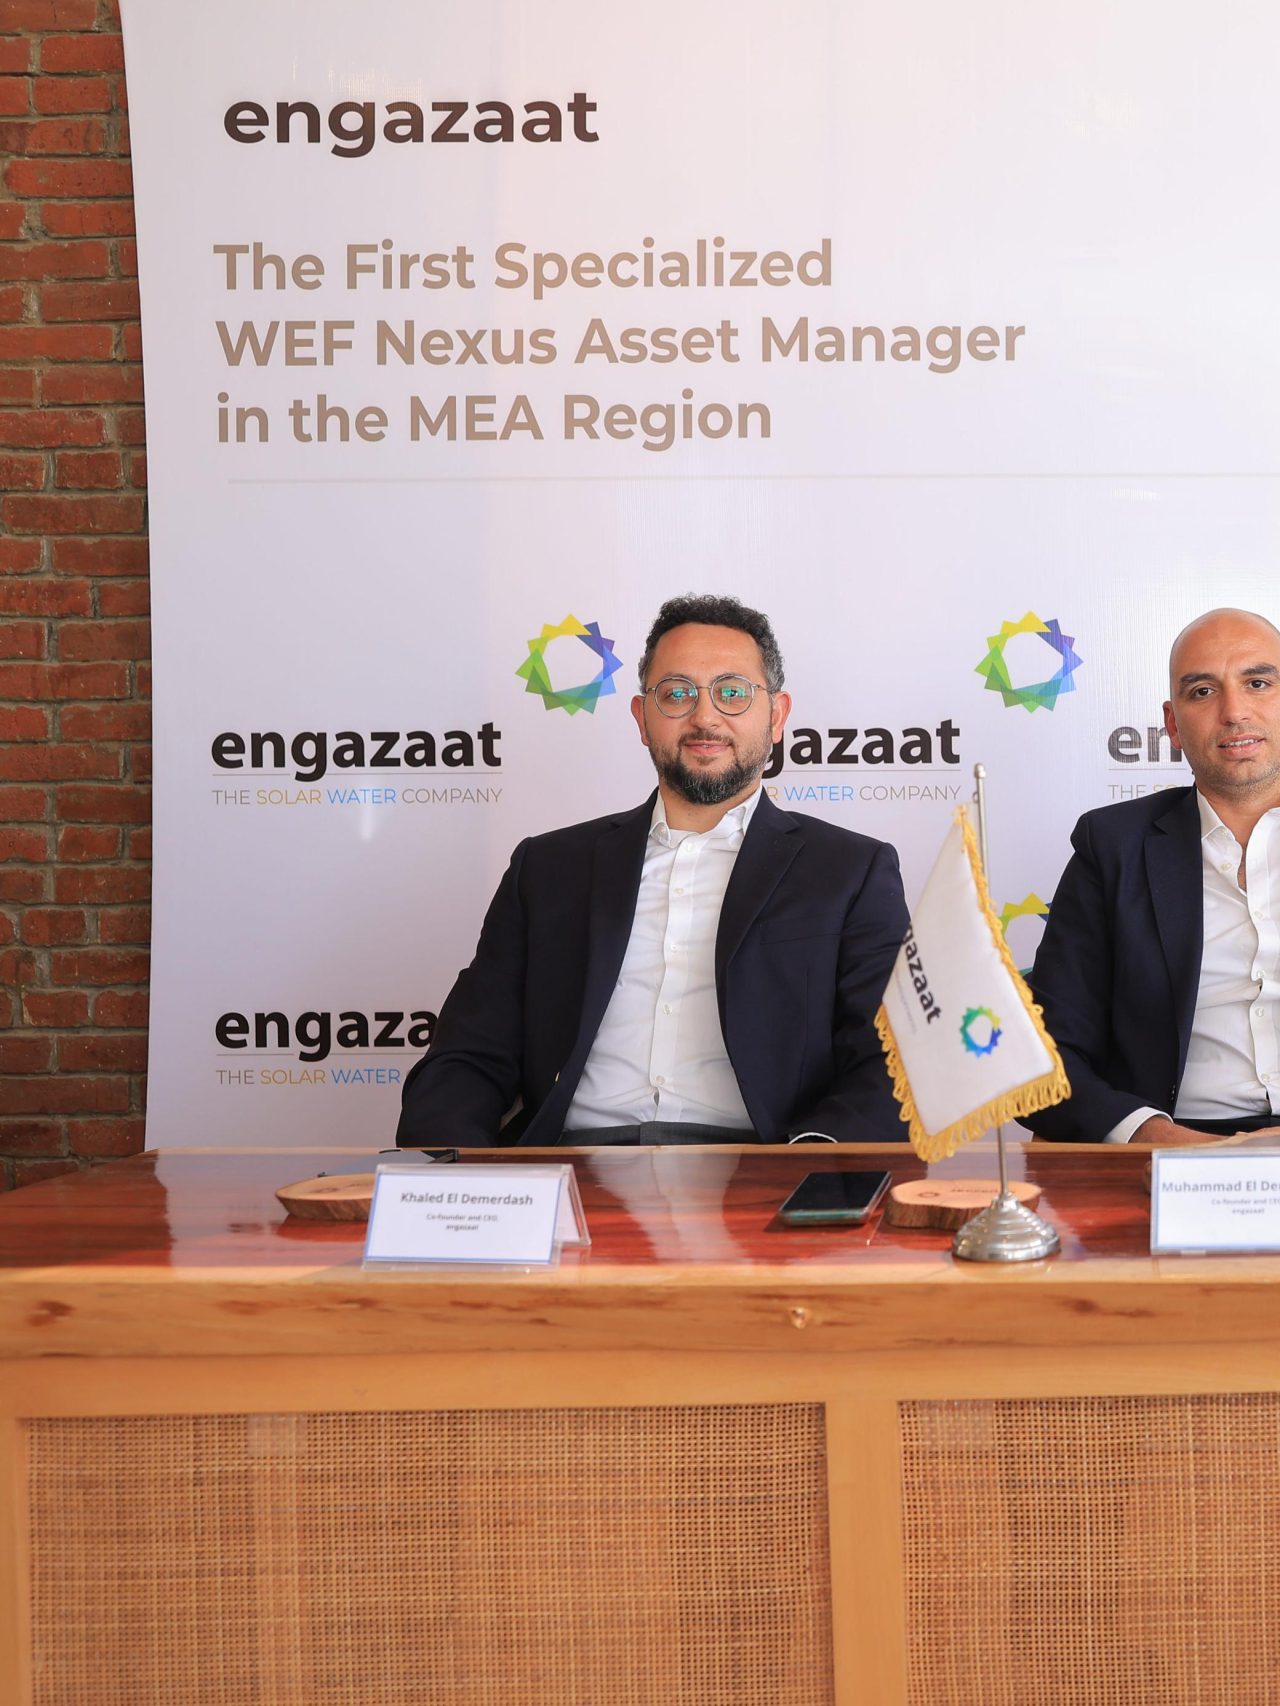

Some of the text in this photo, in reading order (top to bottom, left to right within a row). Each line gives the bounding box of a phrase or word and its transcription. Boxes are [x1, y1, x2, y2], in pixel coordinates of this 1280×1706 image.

[224, 93, 599, 158] engazaat
[213, 236, 831, 300] The First Specialized
[215, 317, 1025, 374] WEF Nexus Asset Manager
[218, 388, 770, 452] in the MEA Region
[211, 722, 502, 782] engazaat
[763, 719, 960, 779] azaat
[212, 788, 503, 805] THE SOLAR WATER COMPANY
[784, 786, 854, 800] WATER
[860, 785, 961, 800] COMPANY
[1107, 785, 1146, 800] THE
[215, 1011, 439, 1062] engaza
[216, 1068, 400, 1085] THE SOLAR WATER
[400, 1192, 533, 1206] Khaled El Demerdash
[1161, 1180, 1242, 1193] Muhammad
[1246, 1180, 1257, 1192] El
